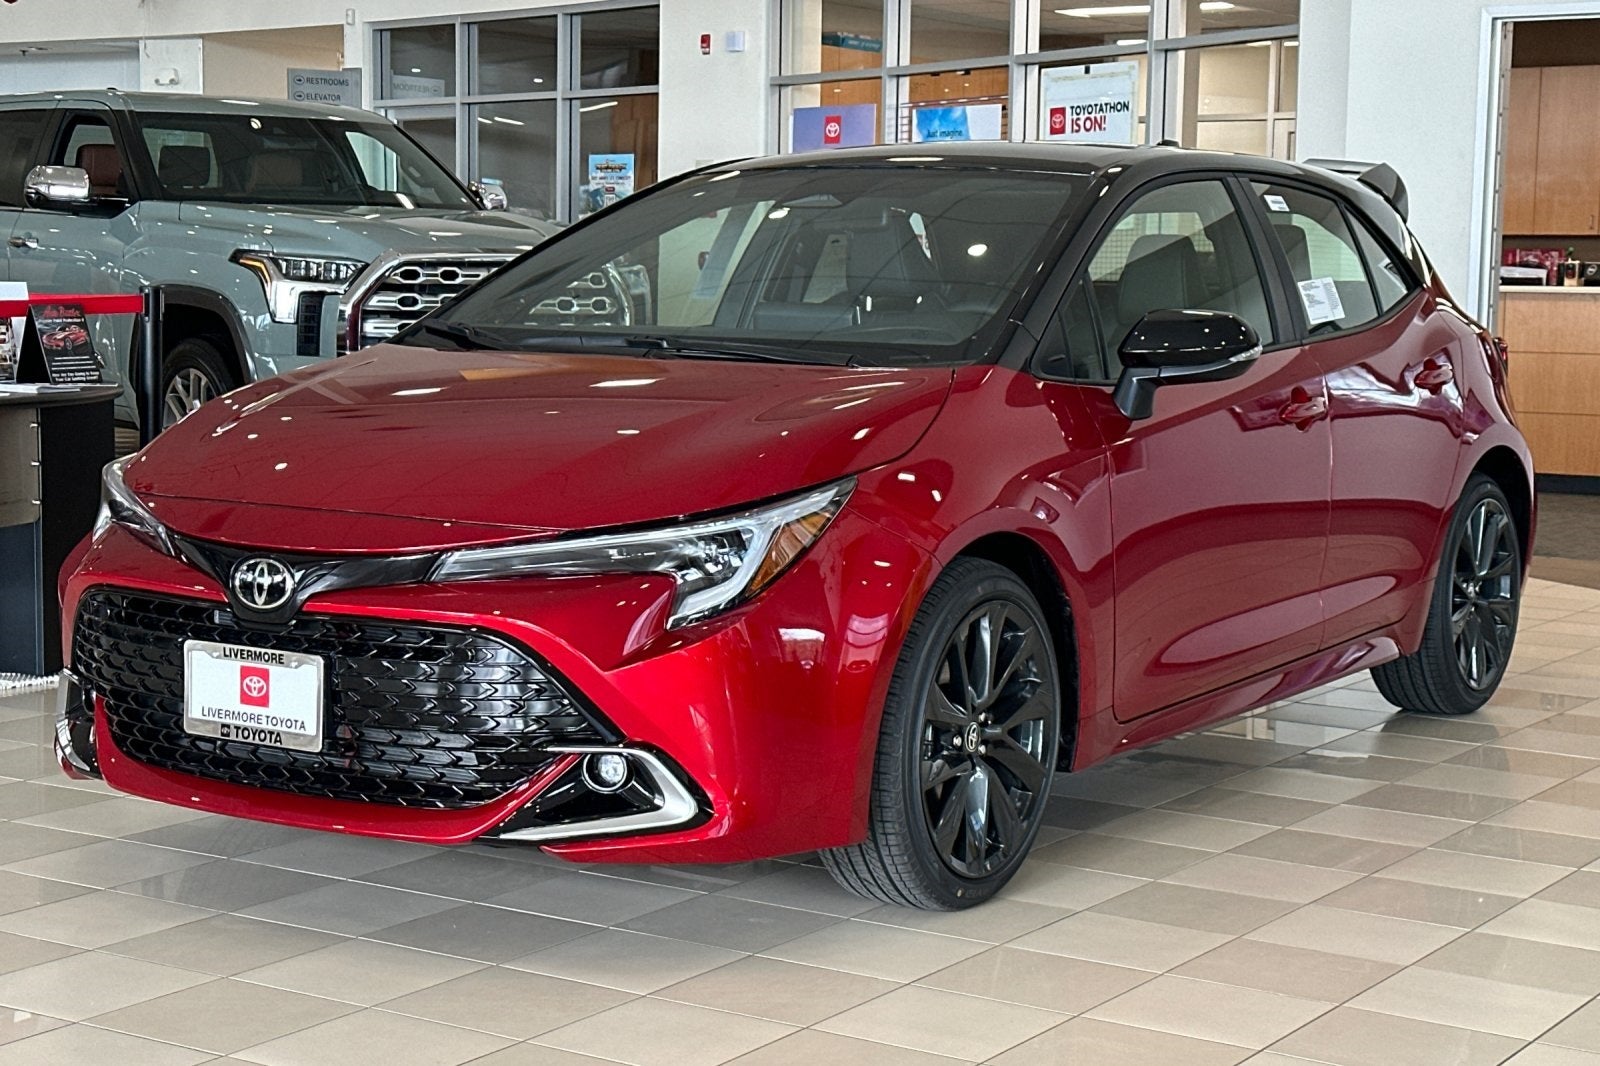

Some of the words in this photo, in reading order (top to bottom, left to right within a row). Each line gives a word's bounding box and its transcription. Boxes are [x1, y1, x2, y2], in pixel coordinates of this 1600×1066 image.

[306, 77, 349, 87] RESTROOMS
[1070, 101, 1129, 116] TOYOTATHON
[1071, 117, 1081, 133] IS
[1083, 115, 1106, 132] ON!
[926, 128, 938, 138] Just
[223, 647, 285, 664] LIVERMORE
[202, 706, 263, 724] LIVERMORE
[266, 715, 306, 731] TOYOTA
[234, 726, 283, 745] TOYOTA
